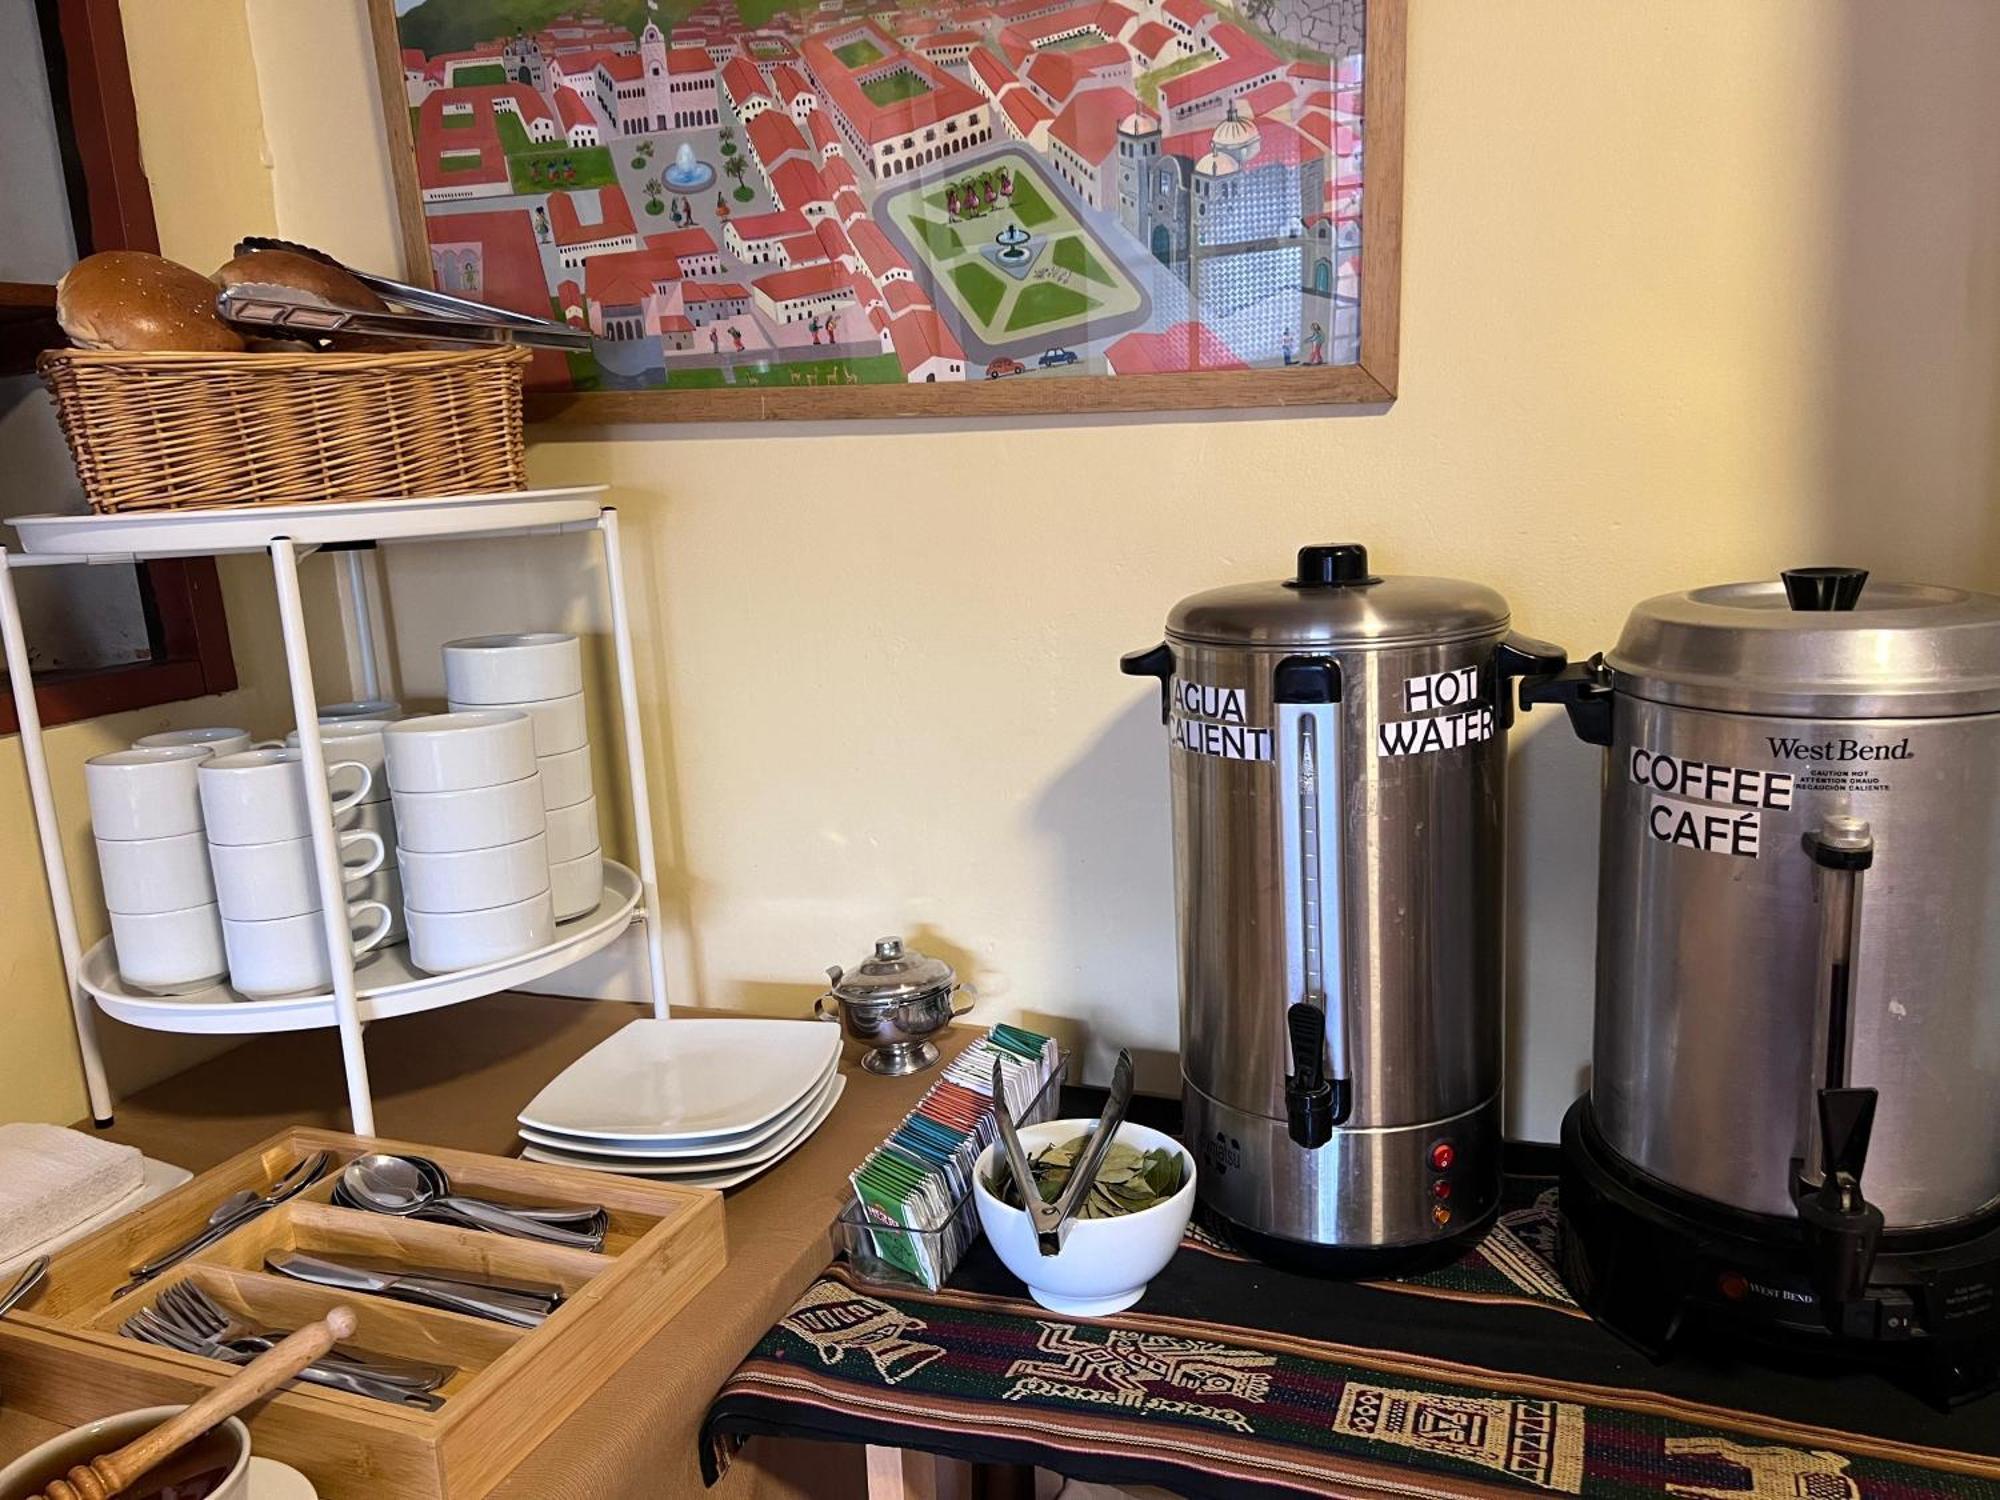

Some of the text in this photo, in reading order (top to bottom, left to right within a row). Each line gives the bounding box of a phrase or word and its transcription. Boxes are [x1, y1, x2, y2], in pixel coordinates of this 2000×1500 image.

[1174, 678, 1244, 722] AGUA
[1405, 667, 1476, 712] HOT
[1380, 706, 1494, 755] WATER
[1766, 737, 1834, 760] West
[1633, 749, 1791, 811] COFFEE
[1794, 784, 1889, 792] RECAUCIÓN CALIENTE
[1650, 805, 1758, 858] CAFÉ
[1750, 1282, 1814, 1304] WEST BEND
